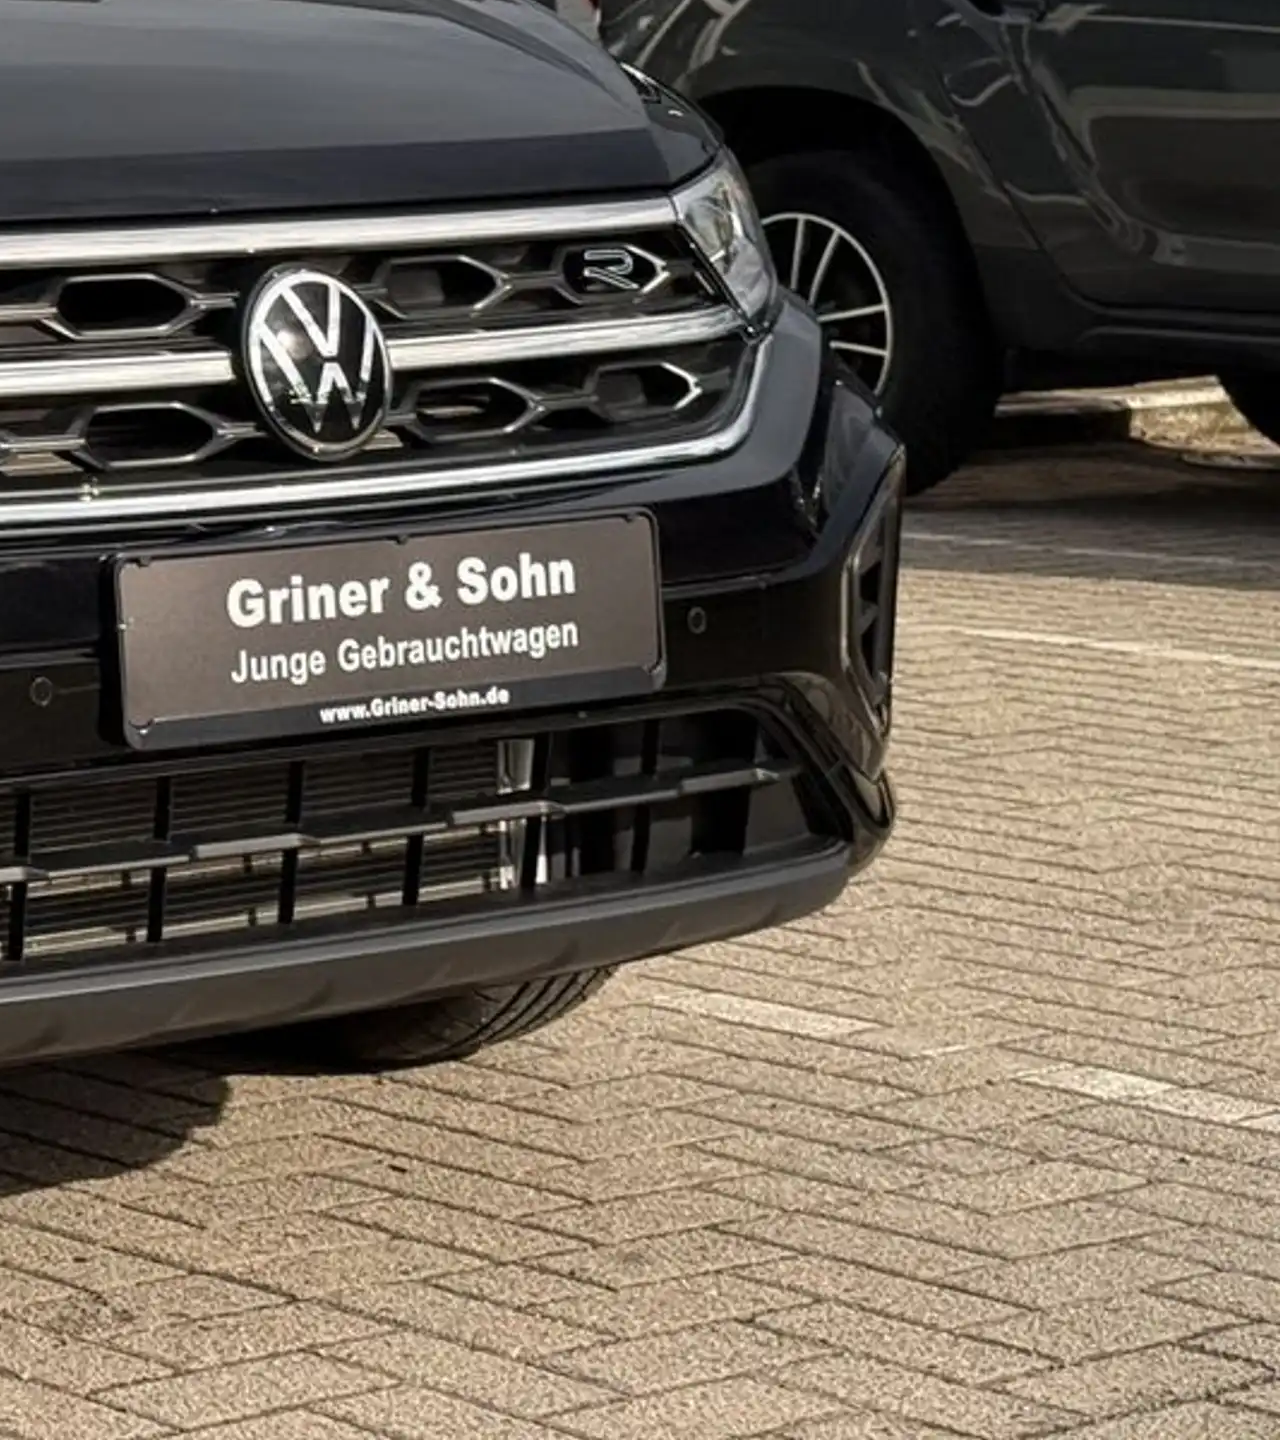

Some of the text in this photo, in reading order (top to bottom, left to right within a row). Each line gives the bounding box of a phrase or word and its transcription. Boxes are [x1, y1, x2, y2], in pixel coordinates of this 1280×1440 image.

[226, 552, 576, 628] Griner & Sohn
[230, 620, 580, 686] Junge Gebrauchtwagen
[319, 686, 510, 725] www.Griner-Sohn.de
